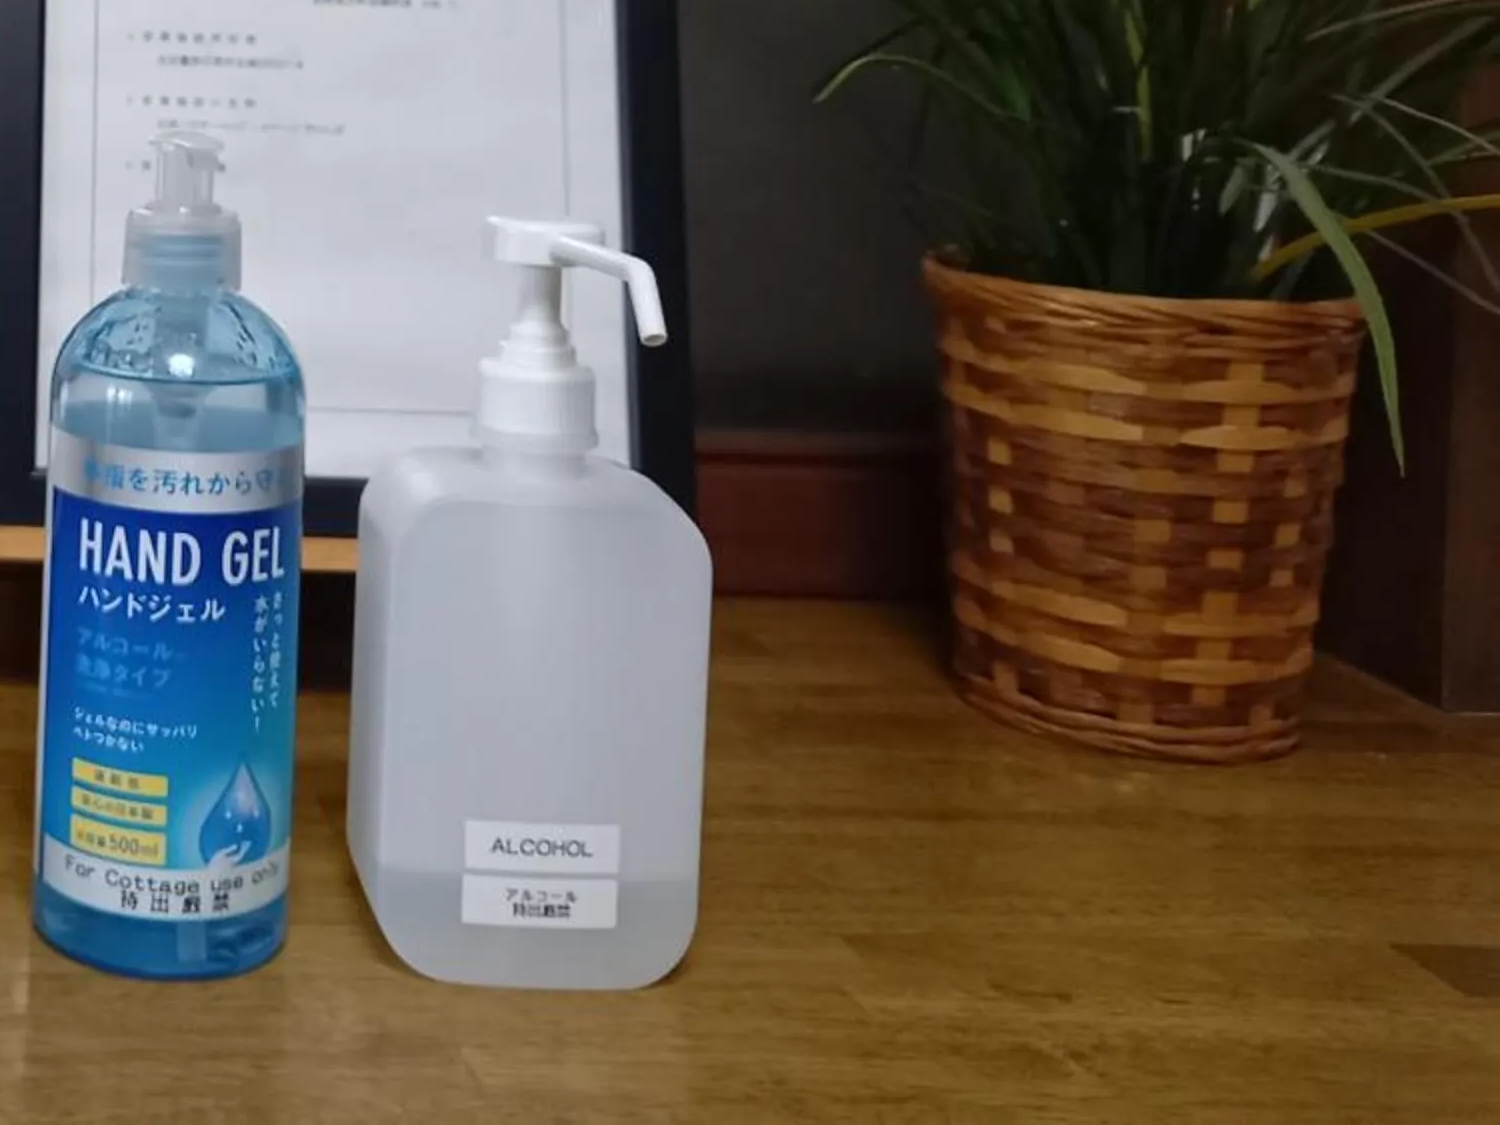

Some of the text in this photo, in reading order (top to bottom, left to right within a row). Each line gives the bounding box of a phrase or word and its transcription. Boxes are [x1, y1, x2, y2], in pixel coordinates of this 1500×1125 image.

[79, 517, 285, 586] HAND GEL
[78, 585, 227, 623] ハンドジェル
[489, 836, 594, 858] ALCOHOL
[64, 854, 96, 878] For
[104, 868, 201, 897] Cottage
[210, 874, 244, 892] use
